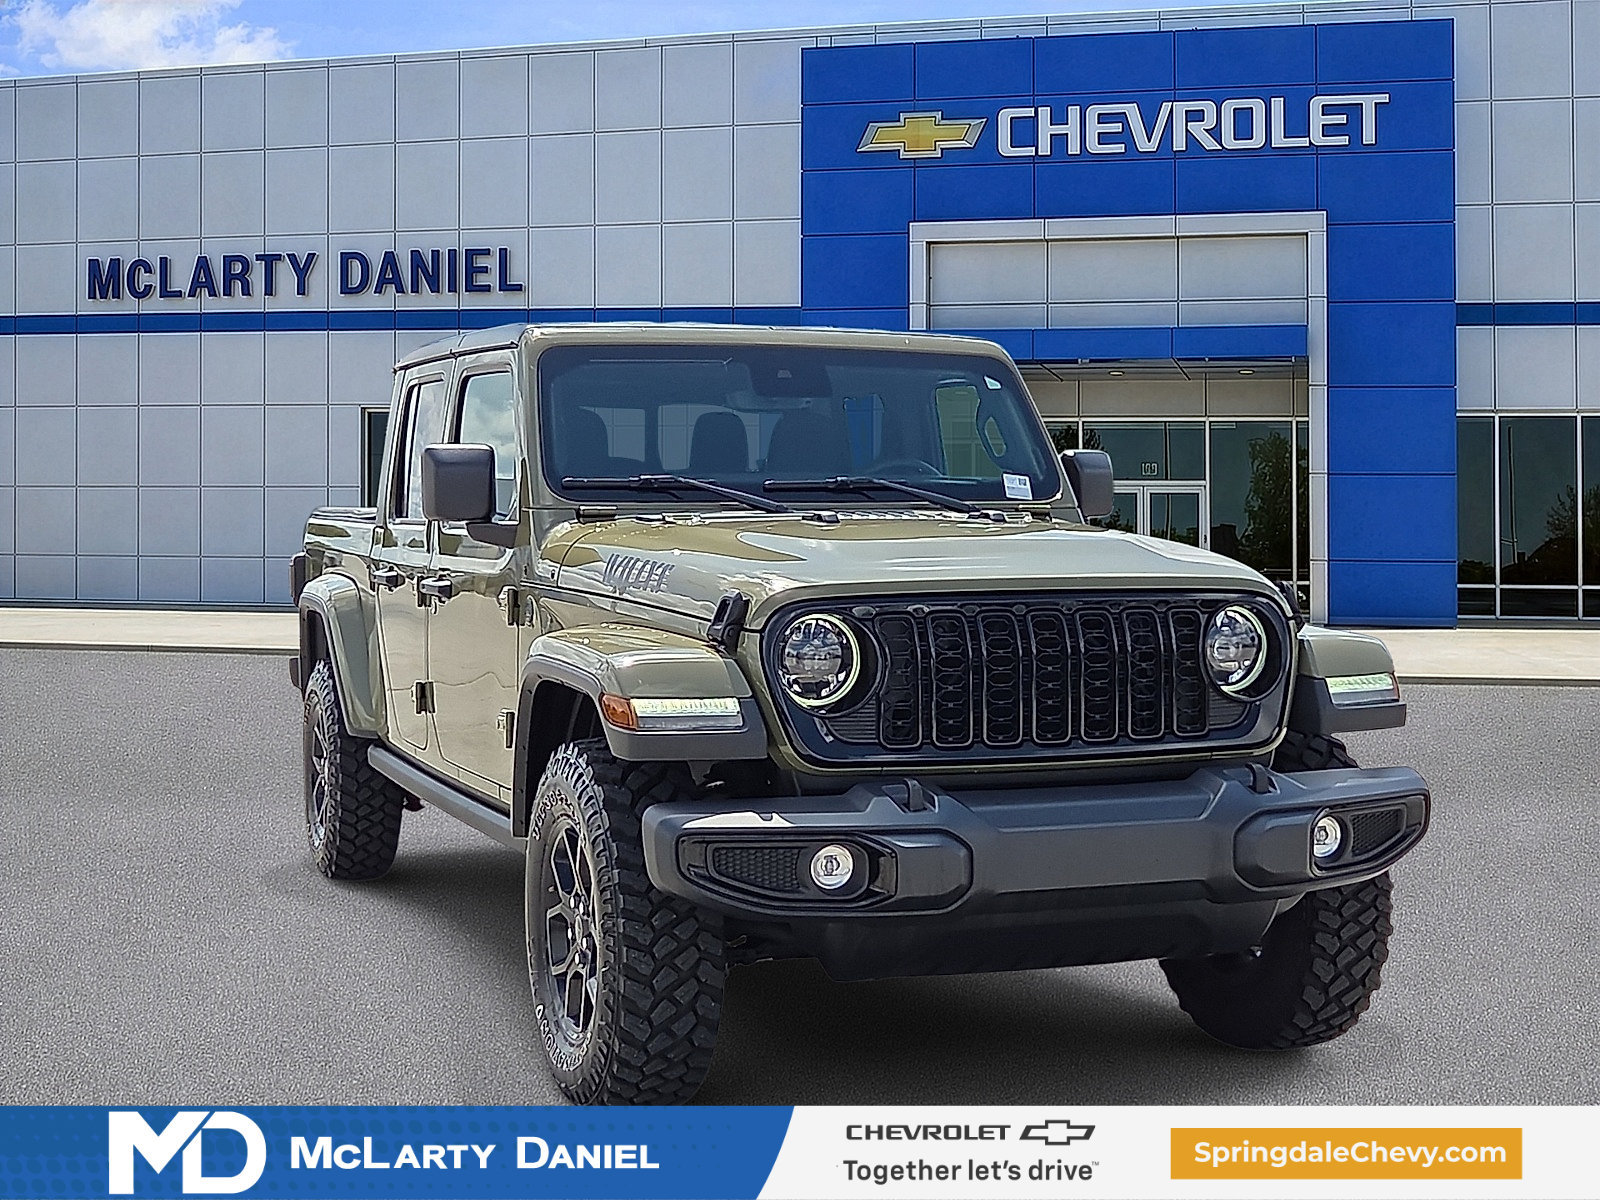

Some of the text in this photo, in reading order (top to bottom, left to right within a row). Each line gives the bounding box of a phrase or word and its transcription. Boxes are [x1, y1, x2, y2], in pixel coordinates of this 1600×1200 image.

[996, 93, 1391, 158] CHEVROLET
[87, 246, 525, 301] MCLARTY DANIEL
